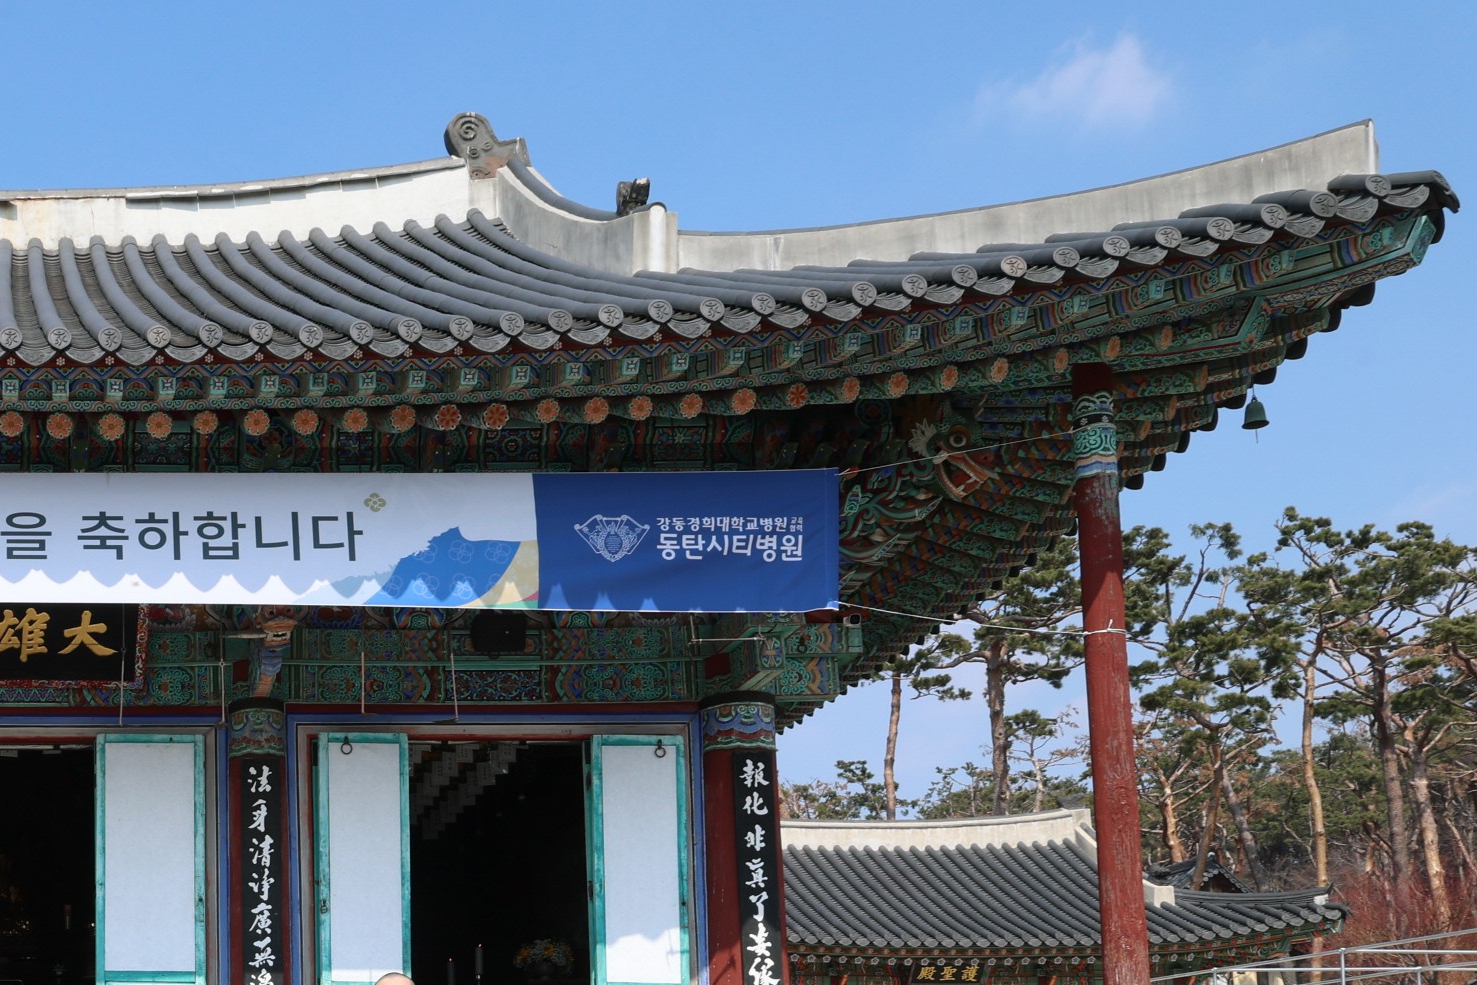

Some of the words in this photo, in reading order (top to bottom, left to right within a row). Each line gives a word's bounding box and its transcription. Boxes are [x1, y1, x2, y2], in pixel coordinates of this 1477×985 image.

[76, 509, 365, 563] 축하합니다
[656, 516, 788, 532] 강동경희대학교병원
[656, 533, 804, 563] 동탄시티병원
